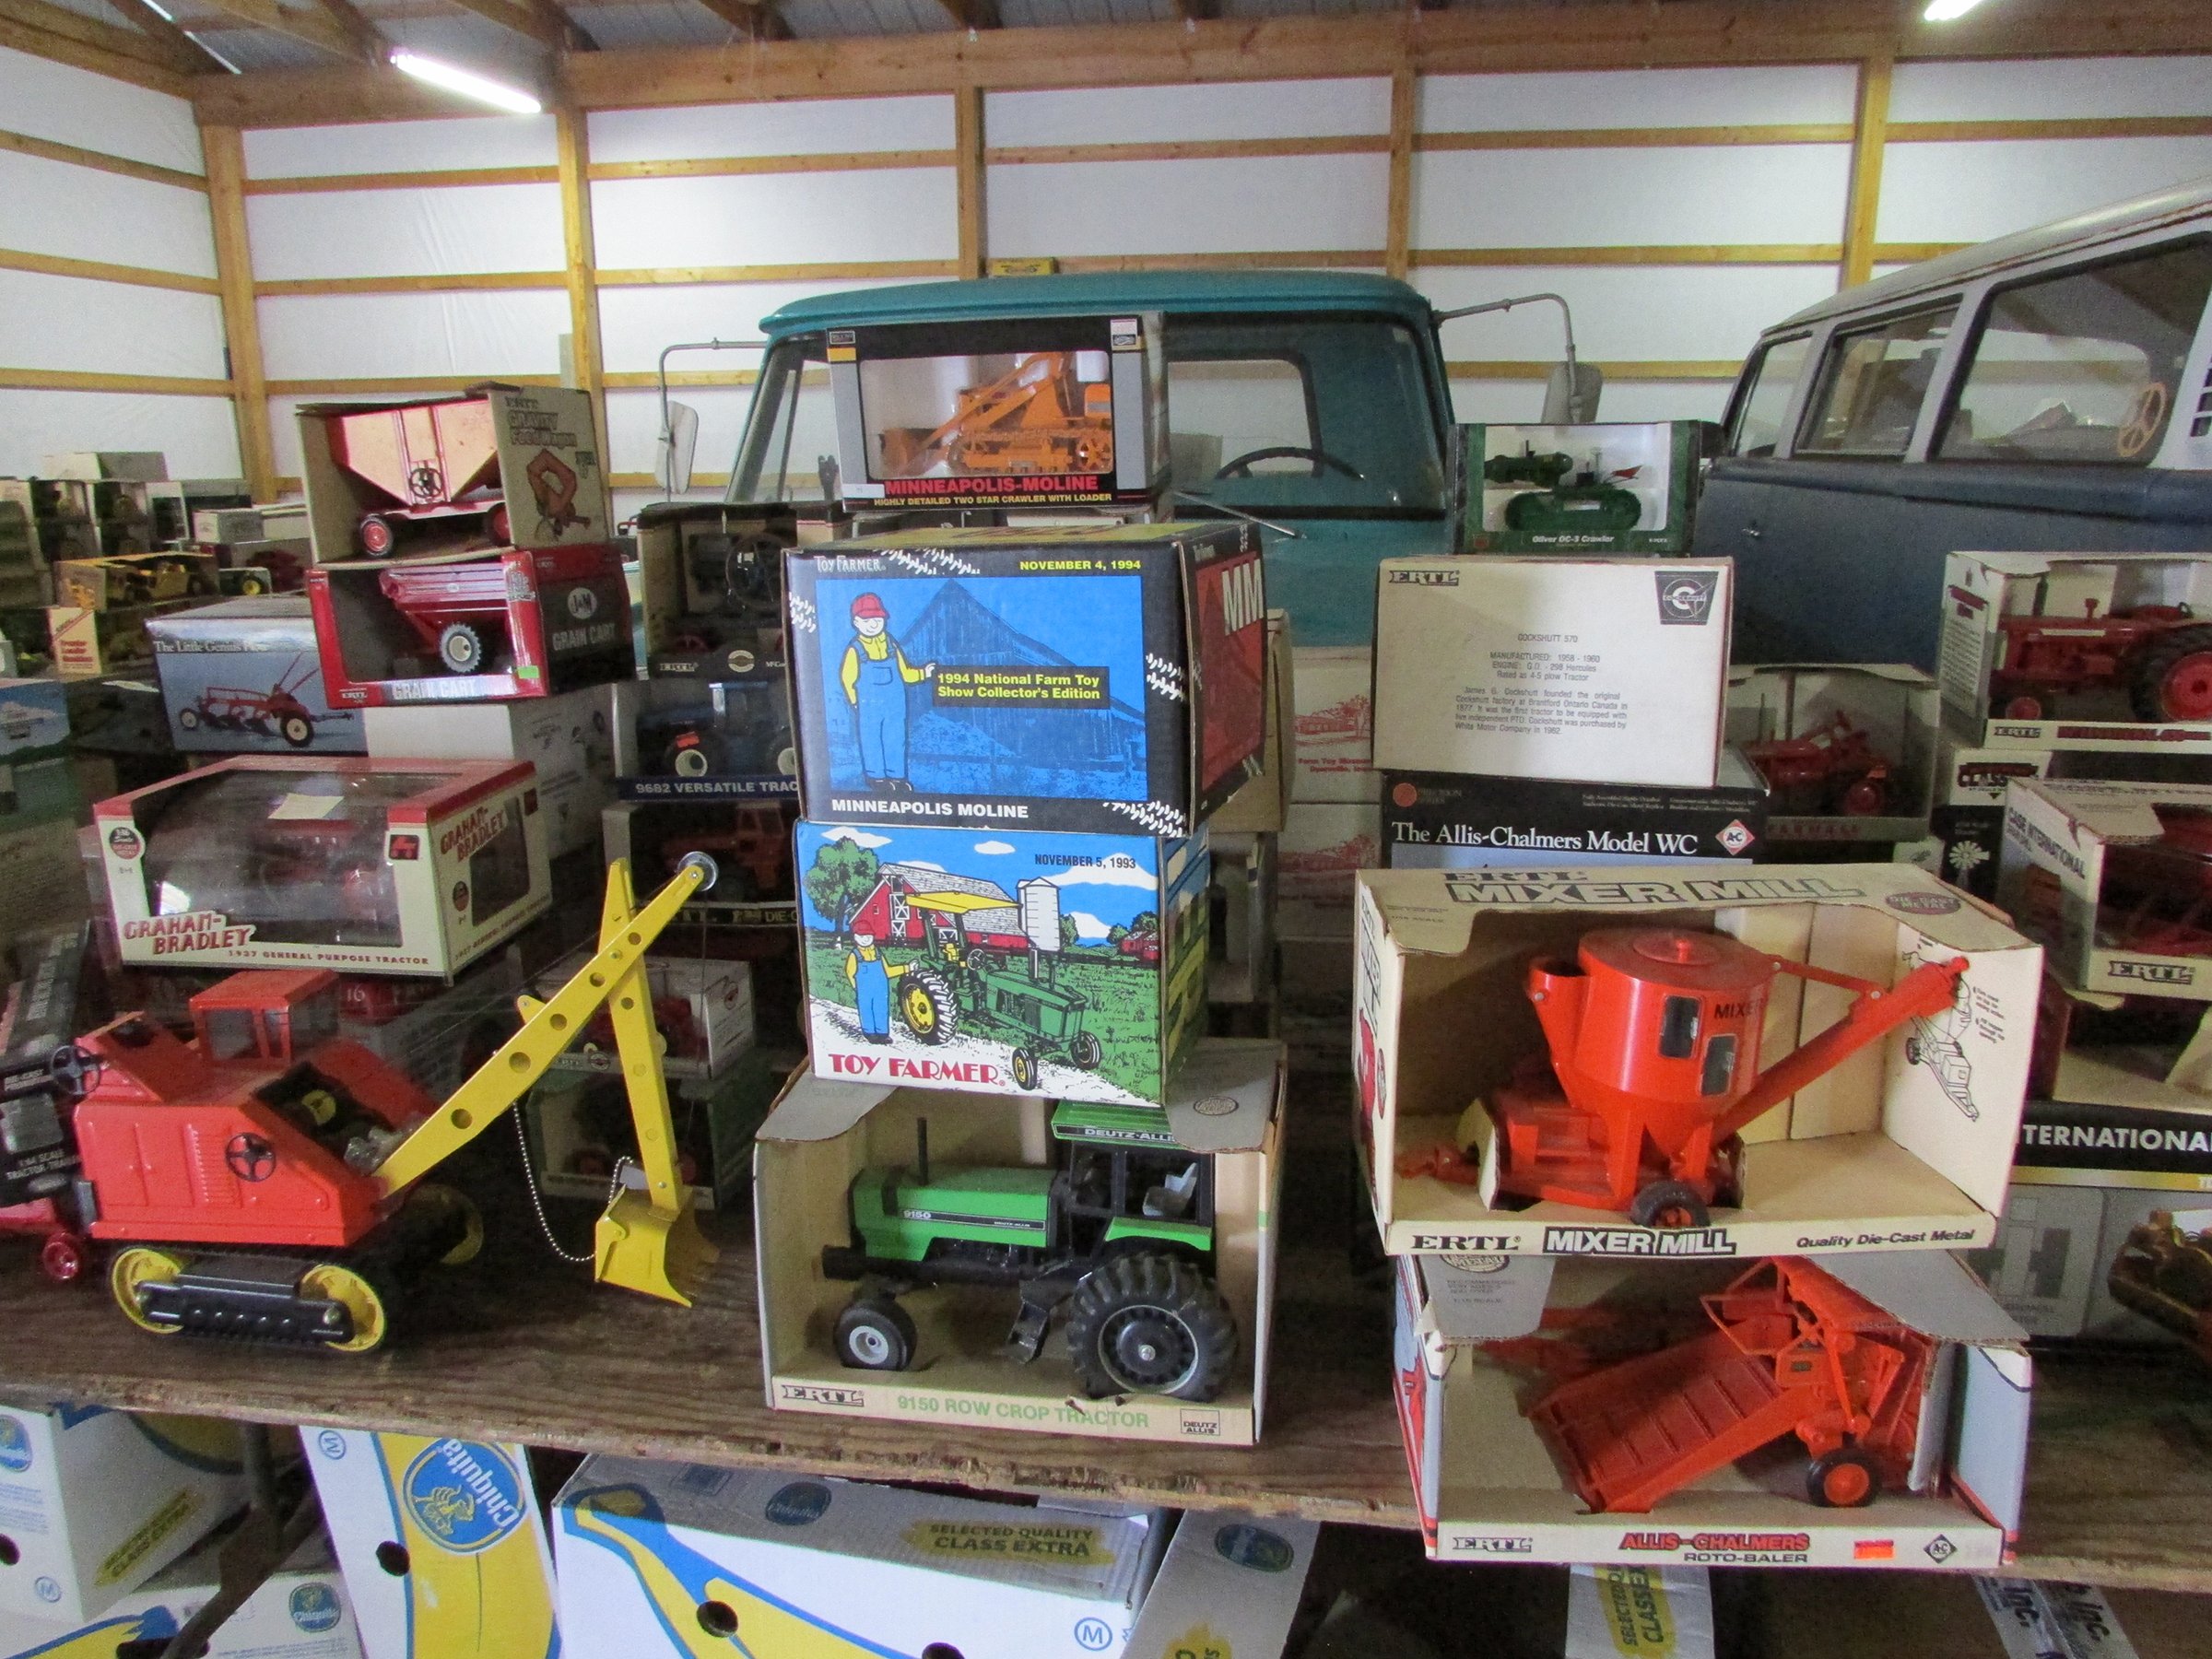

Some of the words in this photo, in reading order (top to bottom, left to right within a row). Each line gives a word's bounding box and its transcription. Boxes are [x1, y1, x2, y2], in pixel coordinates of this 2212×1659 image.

[884, 476, 1100, 495] MINNEAPOLIS-MOLINE
[874, 498, 906, 506] HIGHLY
[908, 497, 951, 505] DETAILED
[954, 496, 974, 504] TWO
[977, 495, 999, 503] STAR
[1002, 494, 1046, 503] CRAWLER
[1048, 494, 1072, 502] WITH
[1074, 492, 1112, 502] LOADER
[1532, 535, 1558, 544] Oliver
[1581, 535, 1615, 544] Crawler
[1020, 560, 1093, 571] NOVEMBER
[1095, 560, 1107, 572] 4,
[1111, 559, 1141, 571] 1994
[1389, 571, 1460, 586] ERTL
[1221, 559, 1264, 636] MM
[1518, 634, 1562, 642] COCKSHUTT
[153, 641, 175, 653] The
[177, 641, 203, 653] Little
[937, 674, 971, 684] 1994
[974, 674, 1032, 685] National
[1036, 674, 1072, 685] Farm
[1075, 675, 1100, 688] Toy
[1545, 672, 1560, 680] plow
[392, 680, 440, 700] GRAIN
[441, 678, 477, 697] CART
[937, 687, 974, 698] Show
[977, 687, 1050, 699] Collector's
[1053, 688, 1101, 699] Edition
[1544, 690, 1572, 699] founded
[1594, 692, 1620, 701] original
[1564, 700, 1589, 708] Ontario
[1592, 701, 1618, 710] Canada
[1531, 708, 1553, 716] tractor
[1566, 709, 1574, 717] be
[1577, 710, 1609, 720] equipped
[1565, 718, 1578, 726] was
[1580, 719, 1616, 729] purchased
[1618, 721, 1627, 729] by
[636, 782, 671, 794] 9682
[675, 782, 756, 794] VERSATILE
[832, 799, 954, 817] MINNEAPOLIS
[958, 804, 1030, 819] MOLINE
[1392, 821, 1431, 842] The
[1436, 823, 1583, 851] Allis-Chalmers
[1586, 830, 1650, 853] Model
[1654, 833, 1700, 855] WC
[1034, 853, 1094, 867] NOVEMBER
[1096, 855, 1107, 870] 5,
[1110, 856, 1137, 869] 1993
[1446, 881, 1688, 905] MIXER
[1684, 877, 1868, 900] MILL
[123, 912, 223, 940] GRAHAM-
[152, 926, 254, 956] BRADLEY
[263, 950, 313, 960] GENERAL
[317, 953, 371, 963] PURPOSE
[376, 955, 429, 966] TRACTOR
[2109, 960, 2193, 985] ERTL
[828, 1053, 882, 1075] TOY
[889, 1058, 999, 1086] FARMER
[902, 1209, 932, 1220] 9150
[1412, 1234, 1520, 1251] ERTL
[1545, 1229, 1655, 1254] MIXER
[1658, 1229, 1735, 1255] MILL
[1797, 1235, 1853, 1249] Quality
[1857, 1231, 1927, 1245] Die-Cast
[1930, 1228, 1976, 1241] Metal
[782, 1384, 865, 1407] ERTL
[897, 1394, 940, 1413] 9150
[944, 1397, 991, 1417] ROW
[995, 1402, 1051, 1421] CROP
[1054, 1406, 1150, 1429] TRACTOR
[1182, 1420, 1218, 1430] DEUTZ
[1185, 1427, 1216, 1435] ALLIS
[441, 1438, 520, 1529] Chiquita
[930, 1524, 1014, 1538] SELECTED
[1018, 1526, 1094, 1541] QUALITY
[934, 1536, 1006, 1552] CLASS
[1013, 1538, 1091, 1557] EXTRA
[1453, 1536, 1533, 1552] ERTL
[1618, 1533, 1810, 1552] ALLIS-CHALMERS
[1684, 1552, 1809, 1563] ROTO-BALER
